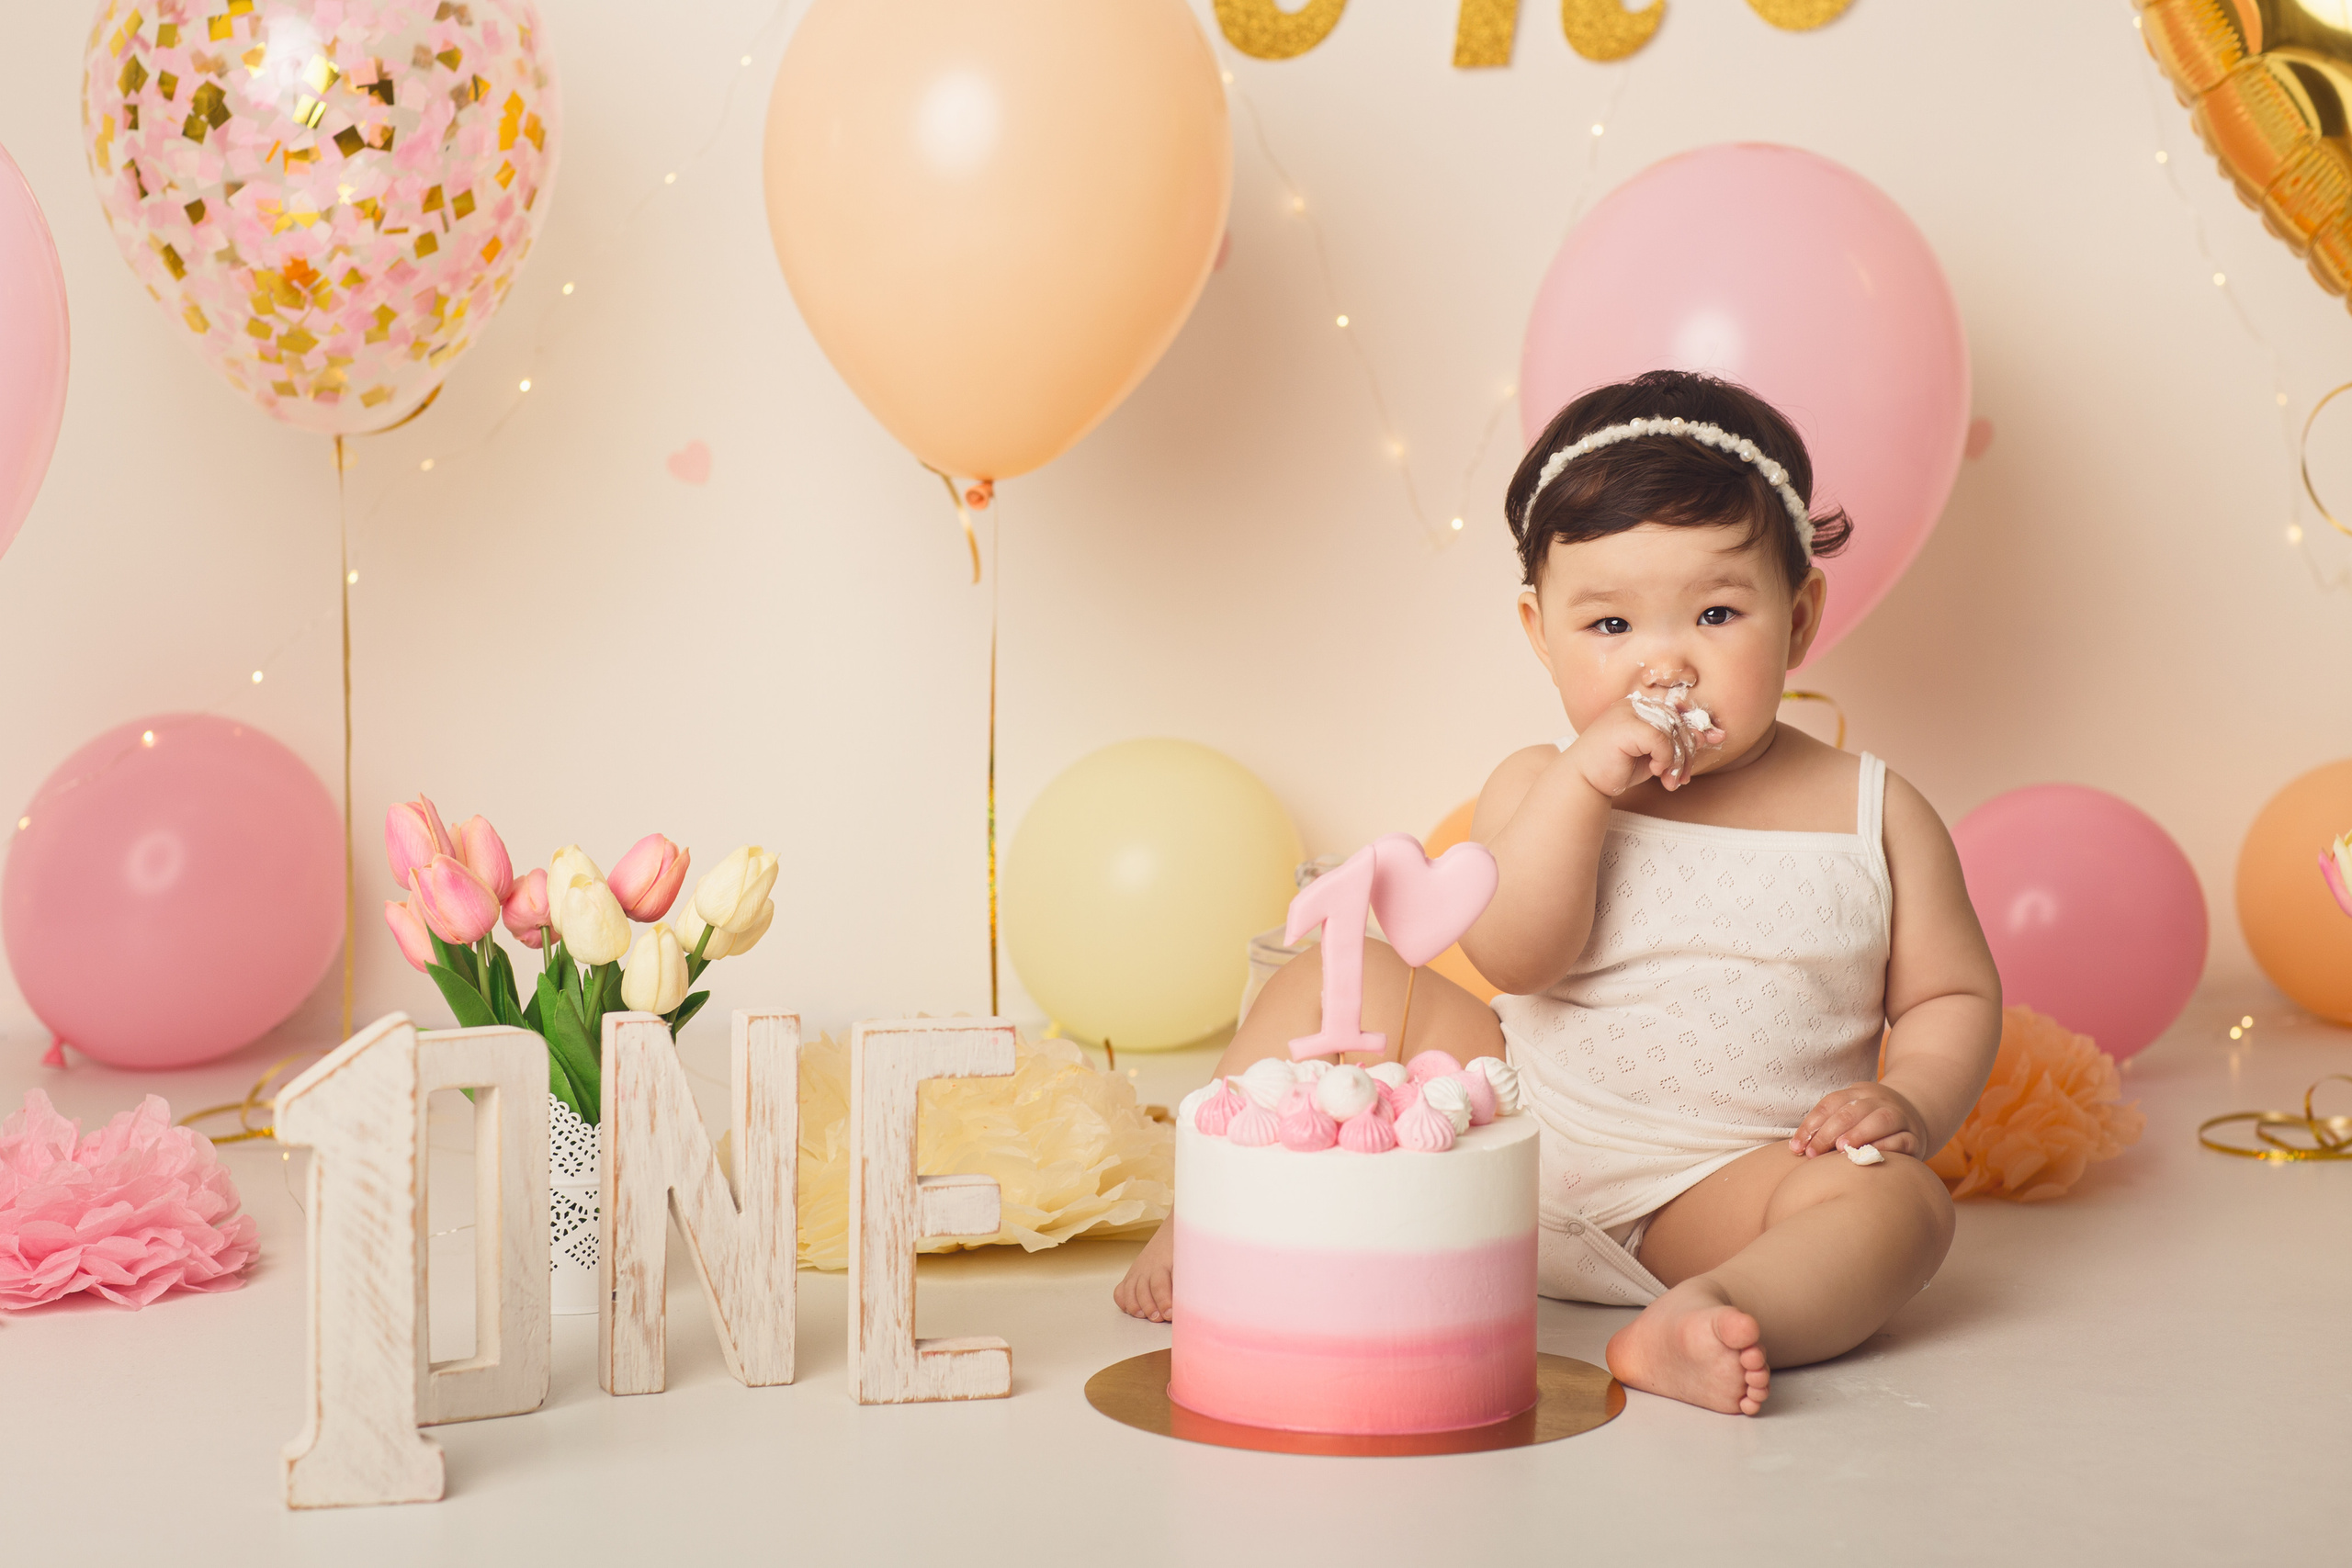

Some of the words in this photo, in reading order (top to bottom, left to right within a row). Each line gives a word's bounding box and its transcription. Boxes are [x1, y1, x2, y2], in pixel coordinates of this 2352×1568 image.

[1283, 842, 1387, 1062] 1
[275, 1011, 445, 1510] 1
[416, 1008, 1017, 1427] ONE
